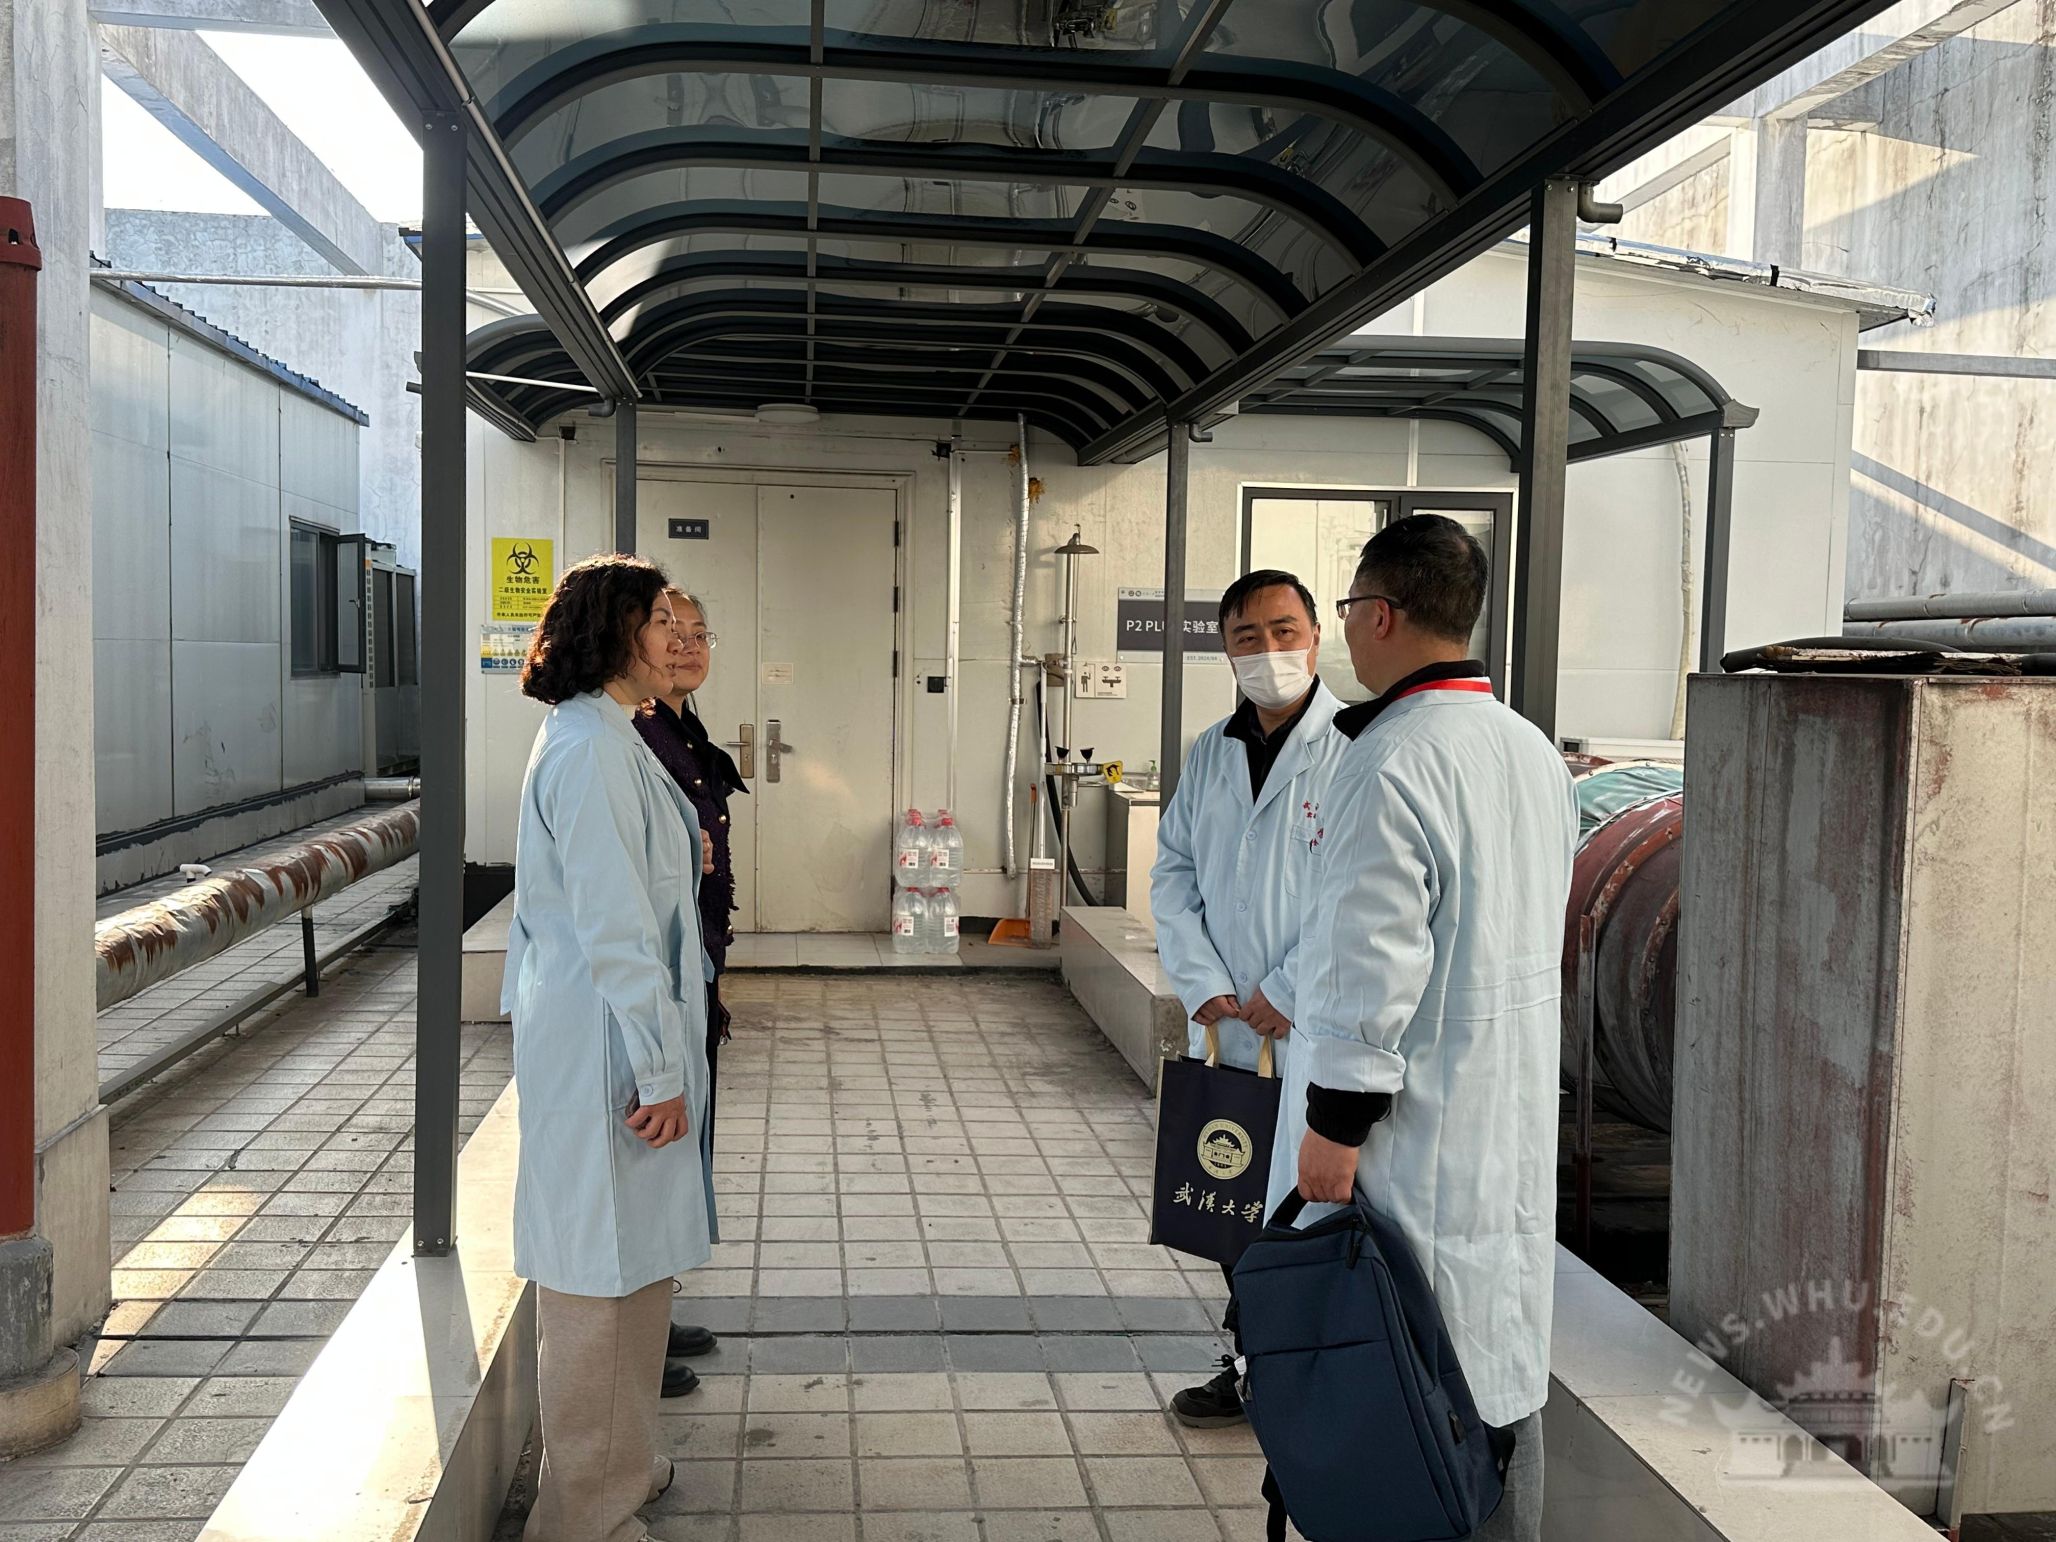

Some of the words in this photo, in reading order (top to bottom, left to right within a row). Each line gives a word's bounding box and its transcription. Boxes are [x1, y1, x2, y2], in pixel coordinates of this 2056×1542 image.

[506, 575, 540, 585] 生物危害
[498, 586, 547, 594] 二级生物安全实验室
[1126, 620, 1142, 632] P2
